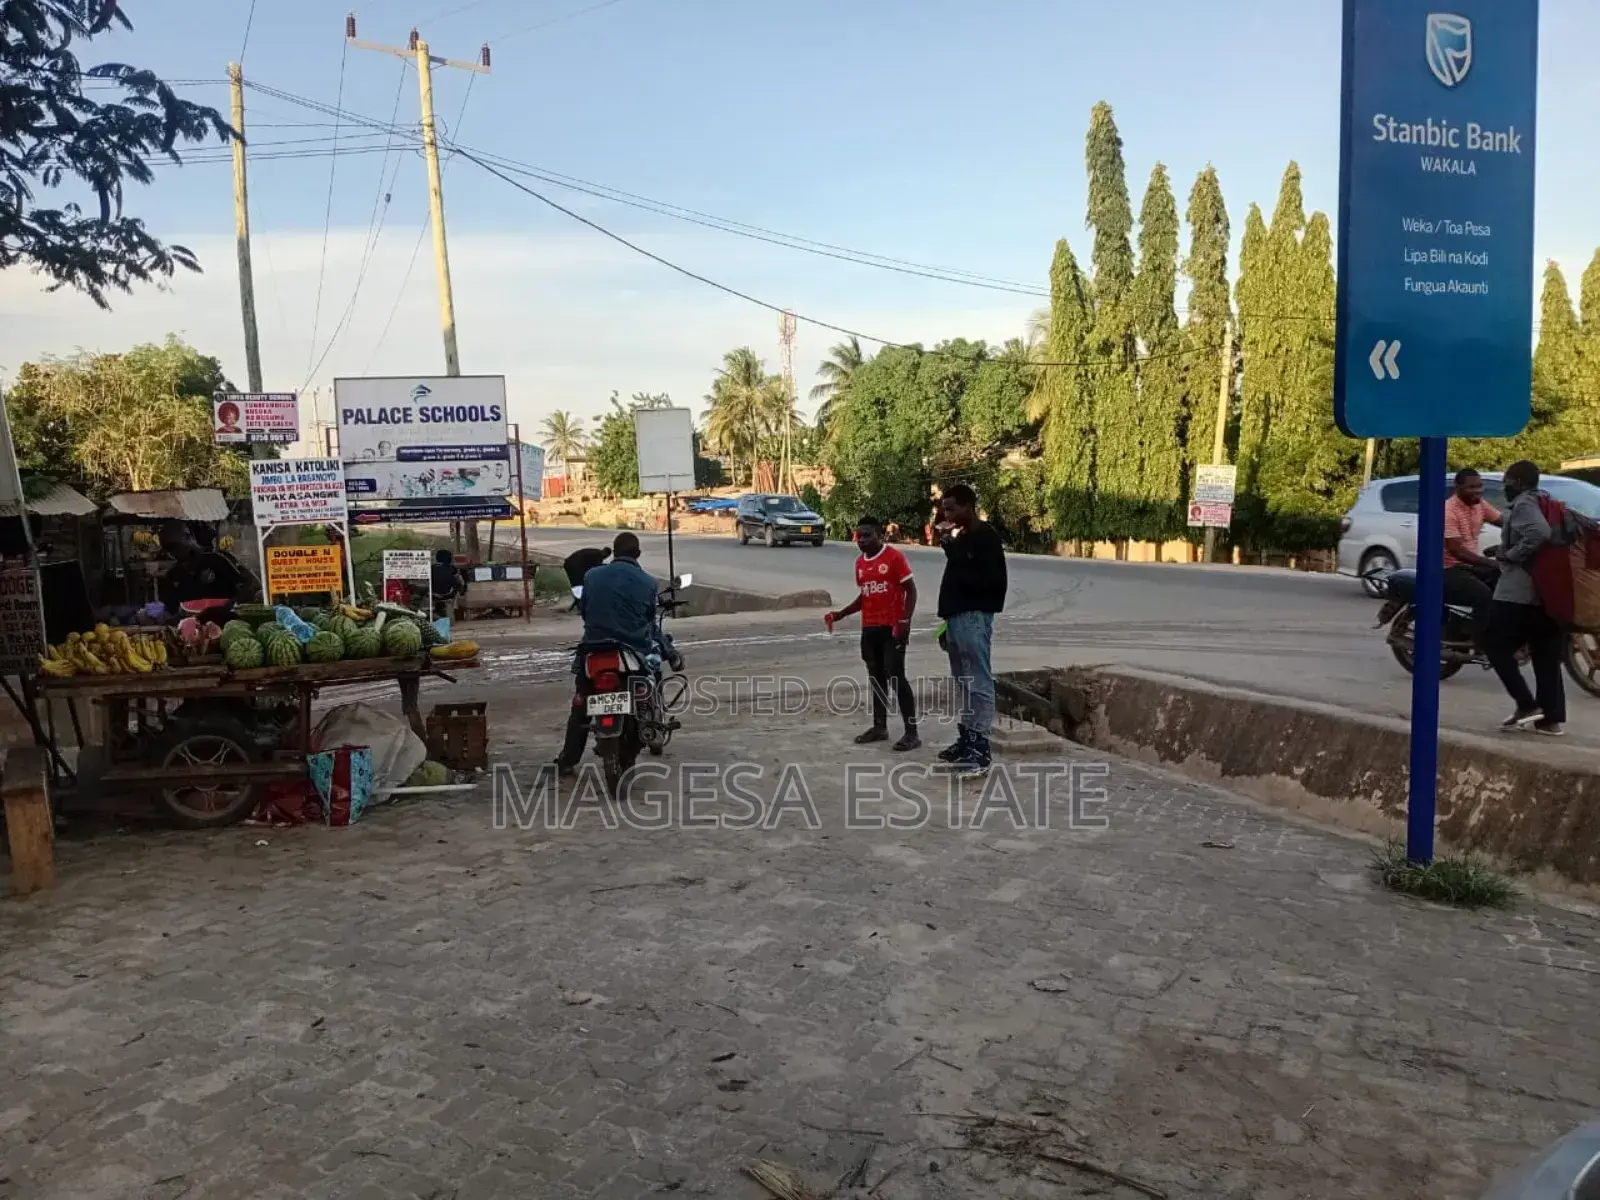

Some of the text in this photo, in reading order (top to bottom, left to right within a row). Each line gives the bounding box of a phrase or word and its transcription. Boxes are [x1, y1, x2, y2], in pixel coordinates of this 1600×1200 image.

[1372, 113, 1522, 154] Stanbic Bank
[1420, 156, 1476, 176] WAKALA
[1402, 216, 1433, 234] Weka
[1444, 219, 1463, 235] Toa
[1465, 220, 1491, 236] Pesa
[1404, 247, 1489, 266] Lipa Bili na Kodi
[1404, 277, 1489, 296] Fungua Akaunti
[342, 404, 502, 425] PALACE SCHOOLS
[252, 460, 340, 475] KANISA KATOLIKI
[261, 475, 282, 484] JIMBO
[285, 474, 296, 483] LA
[258, 490, 340, 502] NYAKASANGWE
